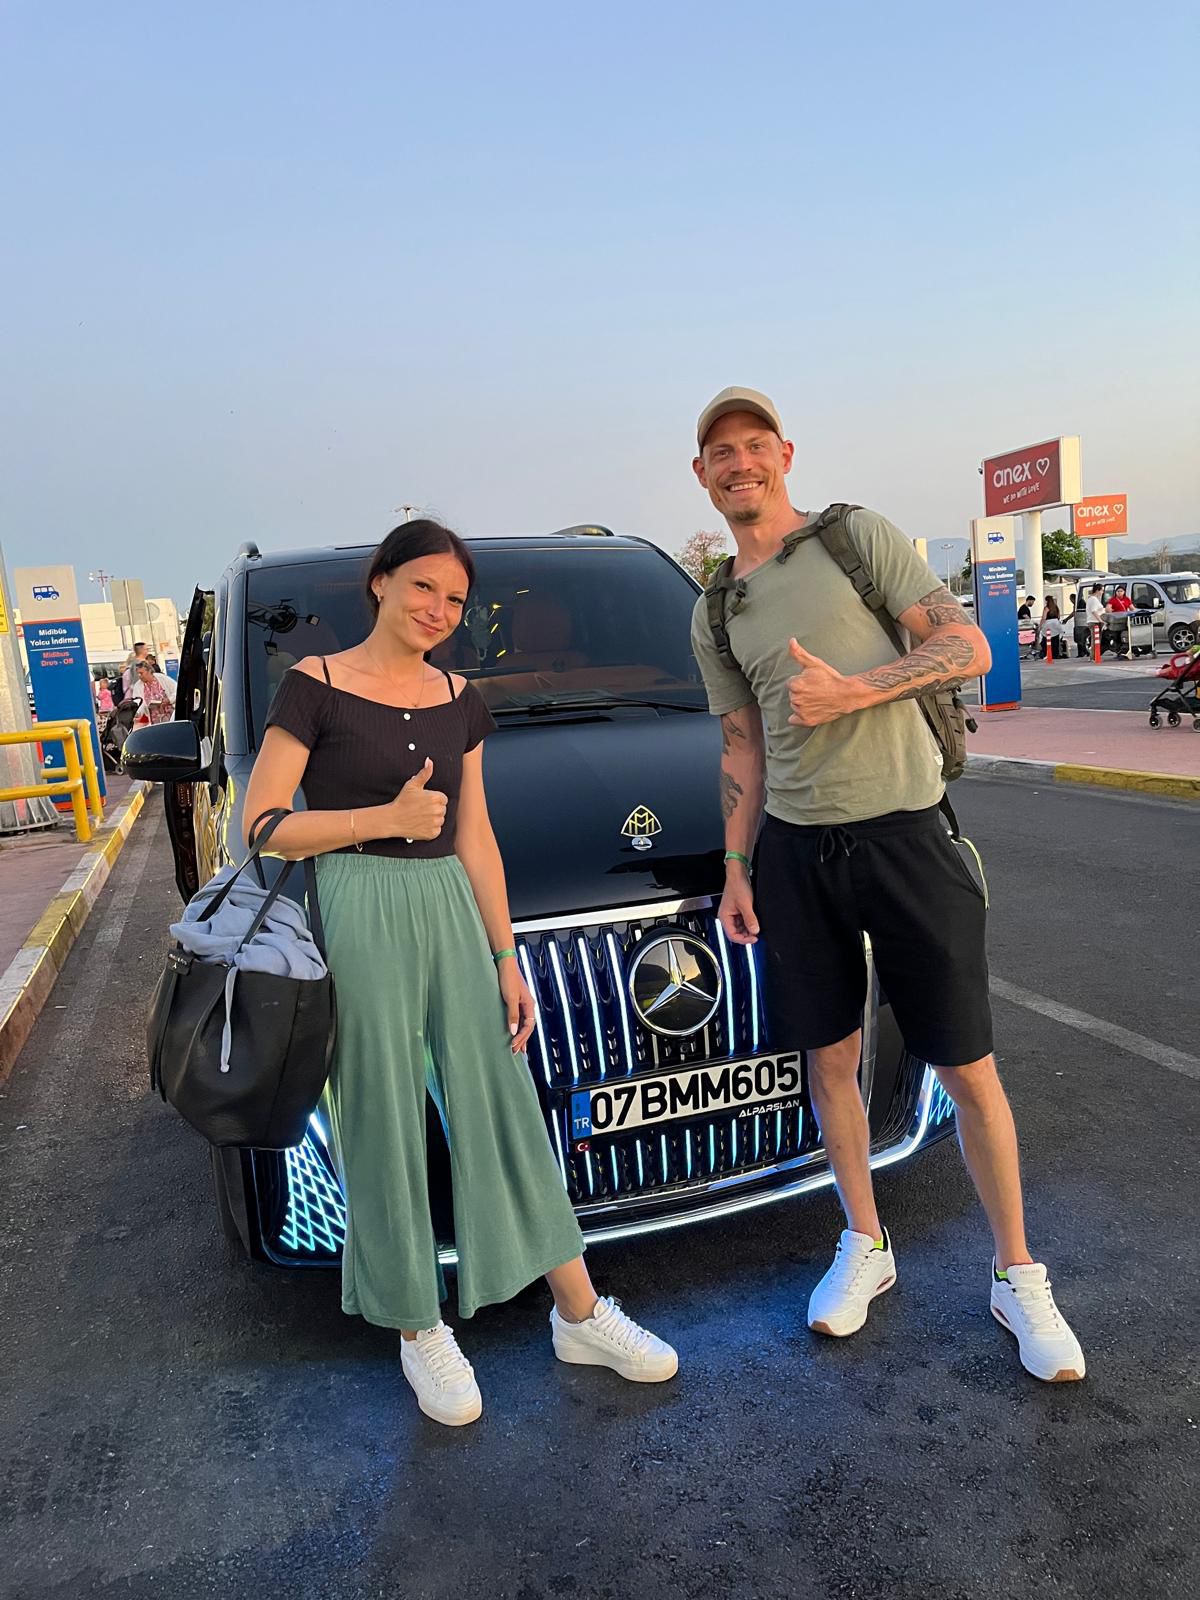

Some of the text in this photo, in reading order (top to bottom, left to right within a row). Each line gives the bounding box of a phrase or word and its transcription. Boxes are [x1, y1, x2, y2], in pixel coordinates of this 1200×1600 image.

[993, 461, 1032, 488] anex
[1028, 482, 1040, 494] LOVE
[1077, 504, 1110, 518] anex
[52, 636, 78, 644] İndirme
[738, 1099, 800, 1118] ALPARSLAN
[574, 1117, 590, 1130] TR
